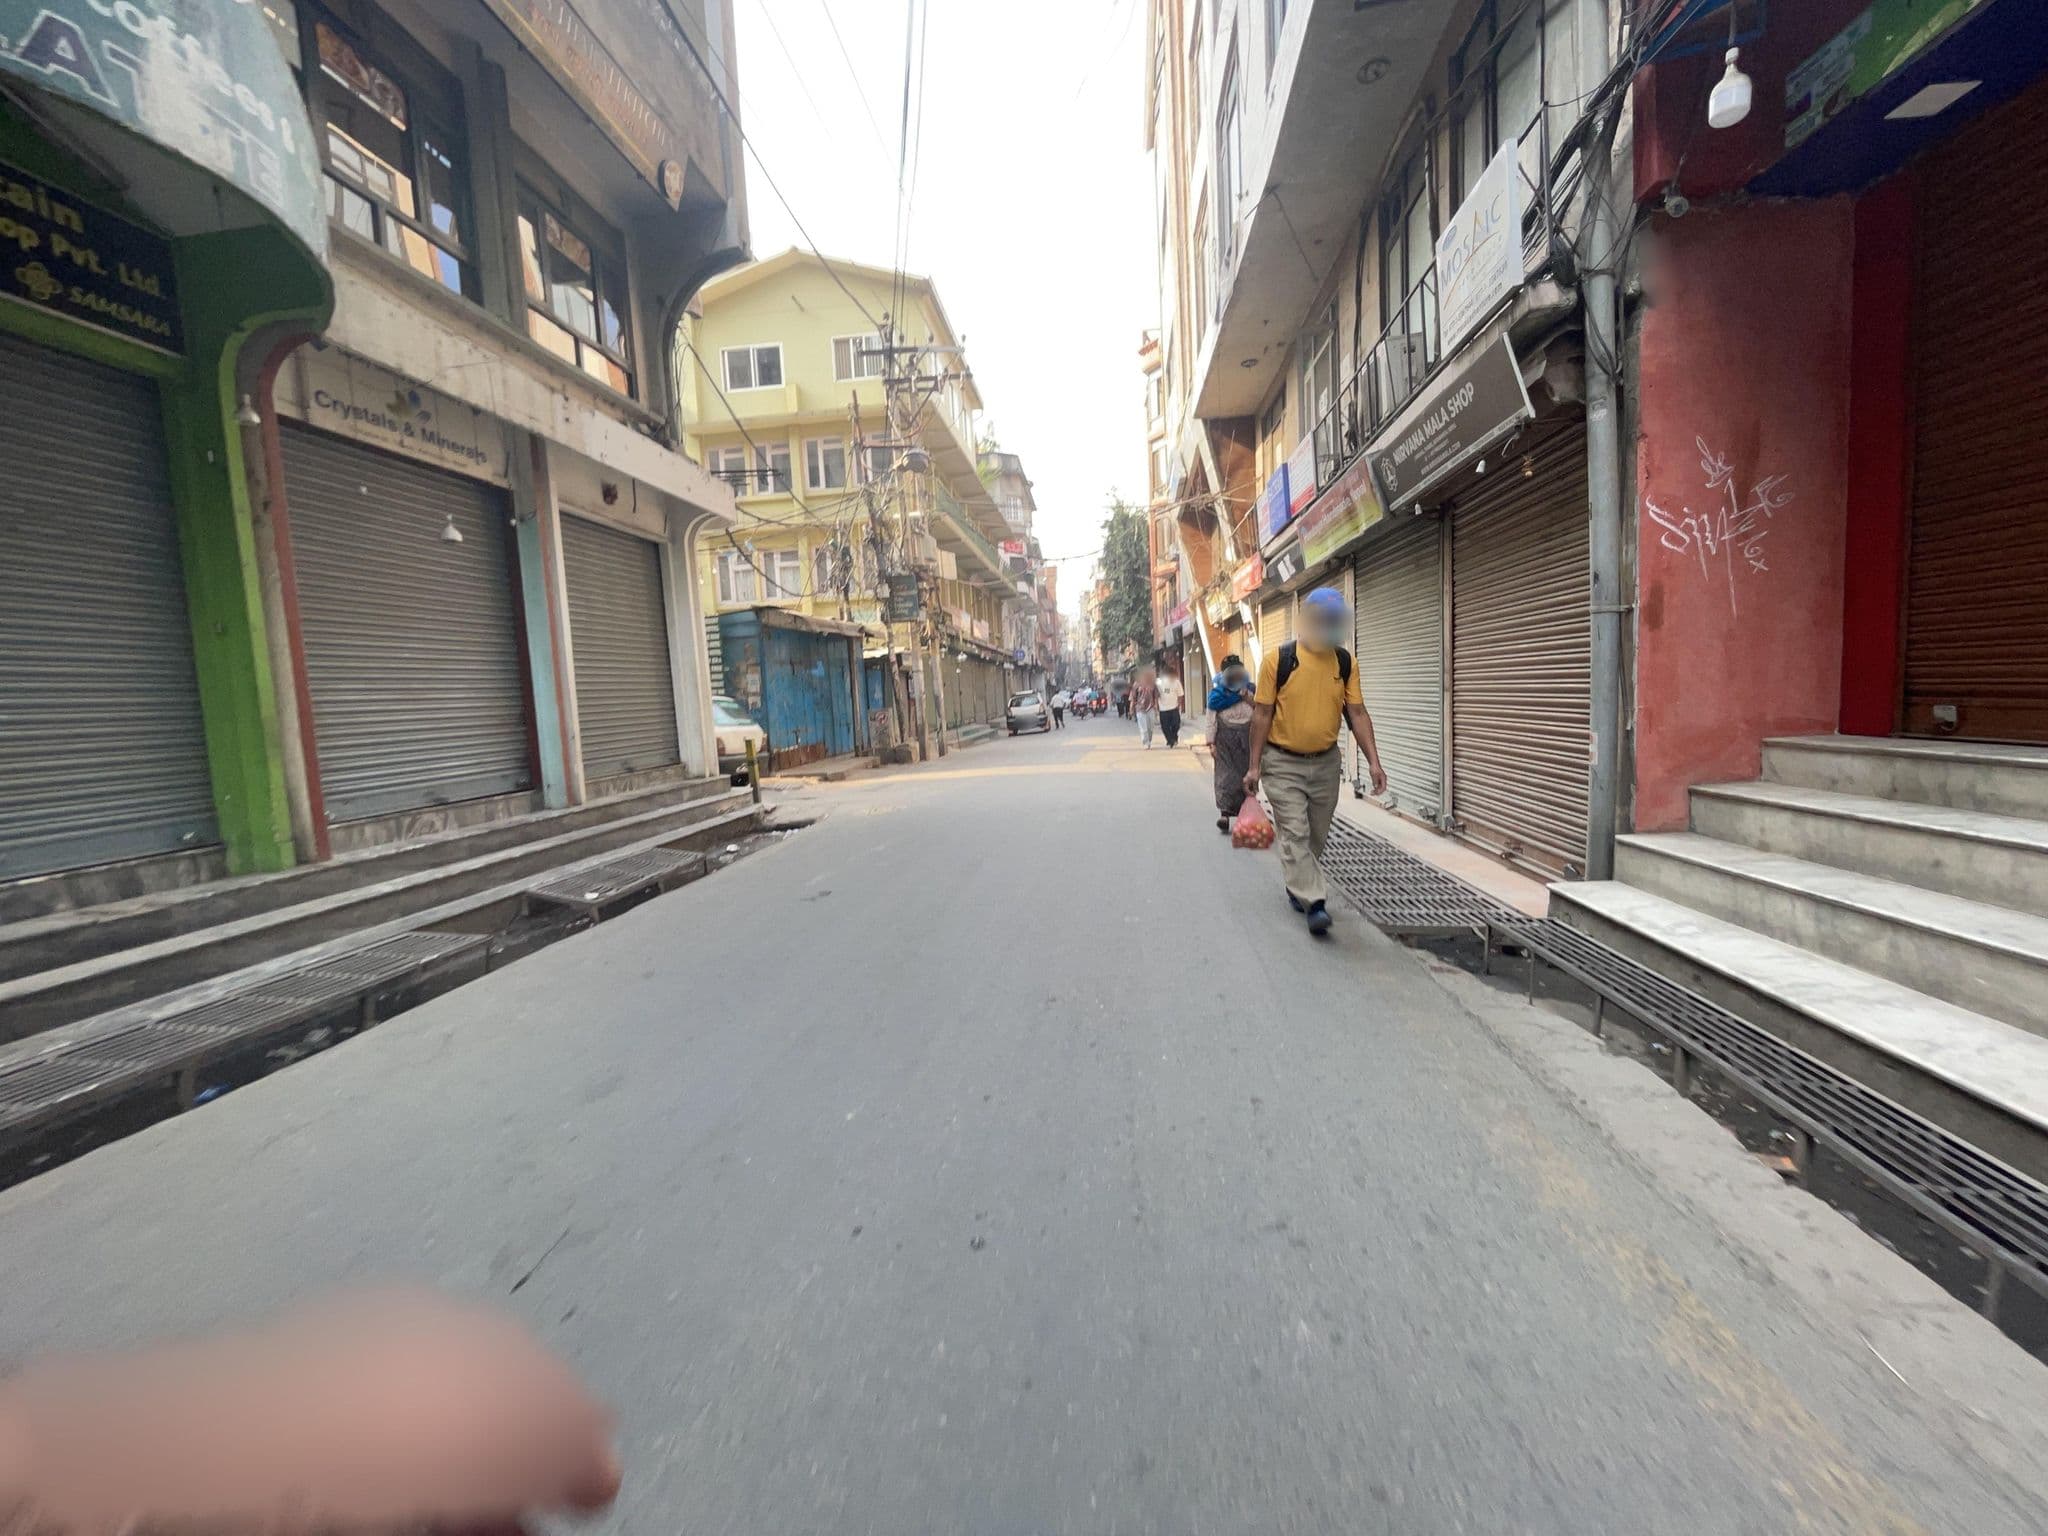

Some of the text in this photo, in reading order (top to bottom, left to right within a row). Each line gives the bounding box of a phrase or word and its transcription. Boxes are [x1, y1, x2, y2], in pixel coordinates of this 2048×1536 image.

[0, 175, 84, 234] ain
[1441, 190, 1504, 294] MOSAIC
[314, 388, 488, 465] Crystals & Minerals
[1392, 428, 1427, 466] NIRVANA
[1422, 406, 1450, 440] MALA
[1447, 381, 1474, 418] SHOP
